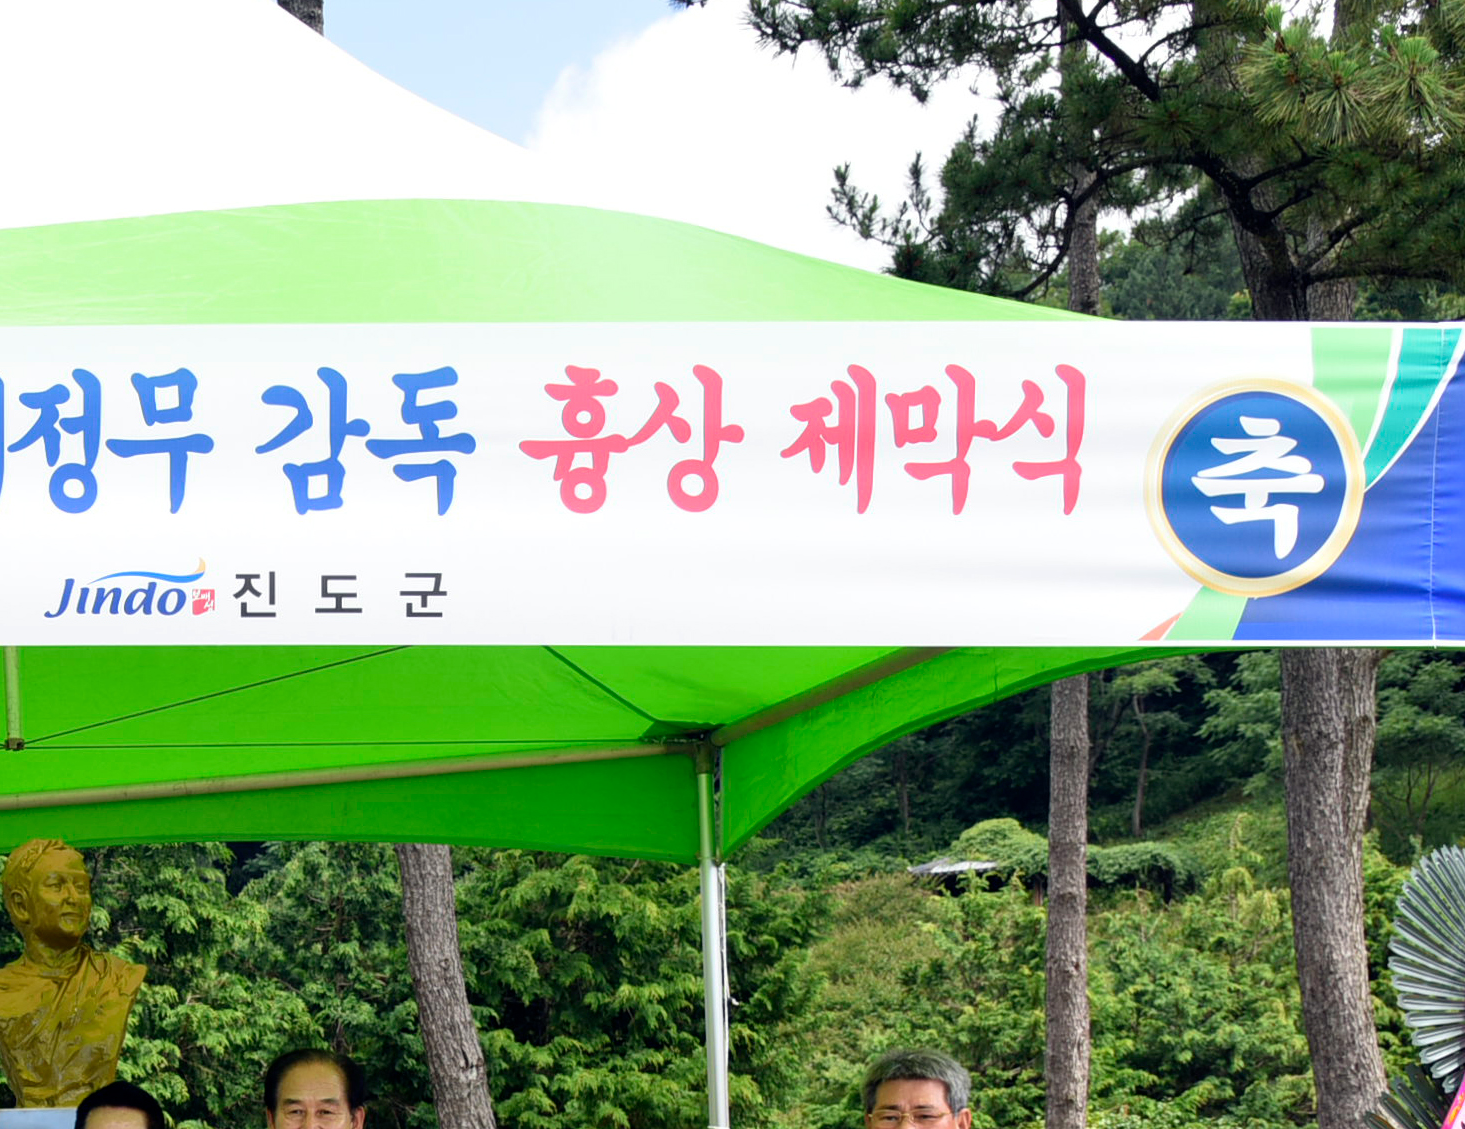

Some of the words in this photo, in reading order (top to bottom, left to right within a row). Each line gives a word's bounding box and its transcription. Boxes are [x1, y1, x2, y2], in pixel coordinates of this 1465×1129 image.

[255, 365, 478, 517] 감독
[519, 363, 746, 515] 흉상
[779, 363, 1087, 517] 제막식
[1191, 415, 1325, 560] 축
[44, 578, 187, 619] Jindo
